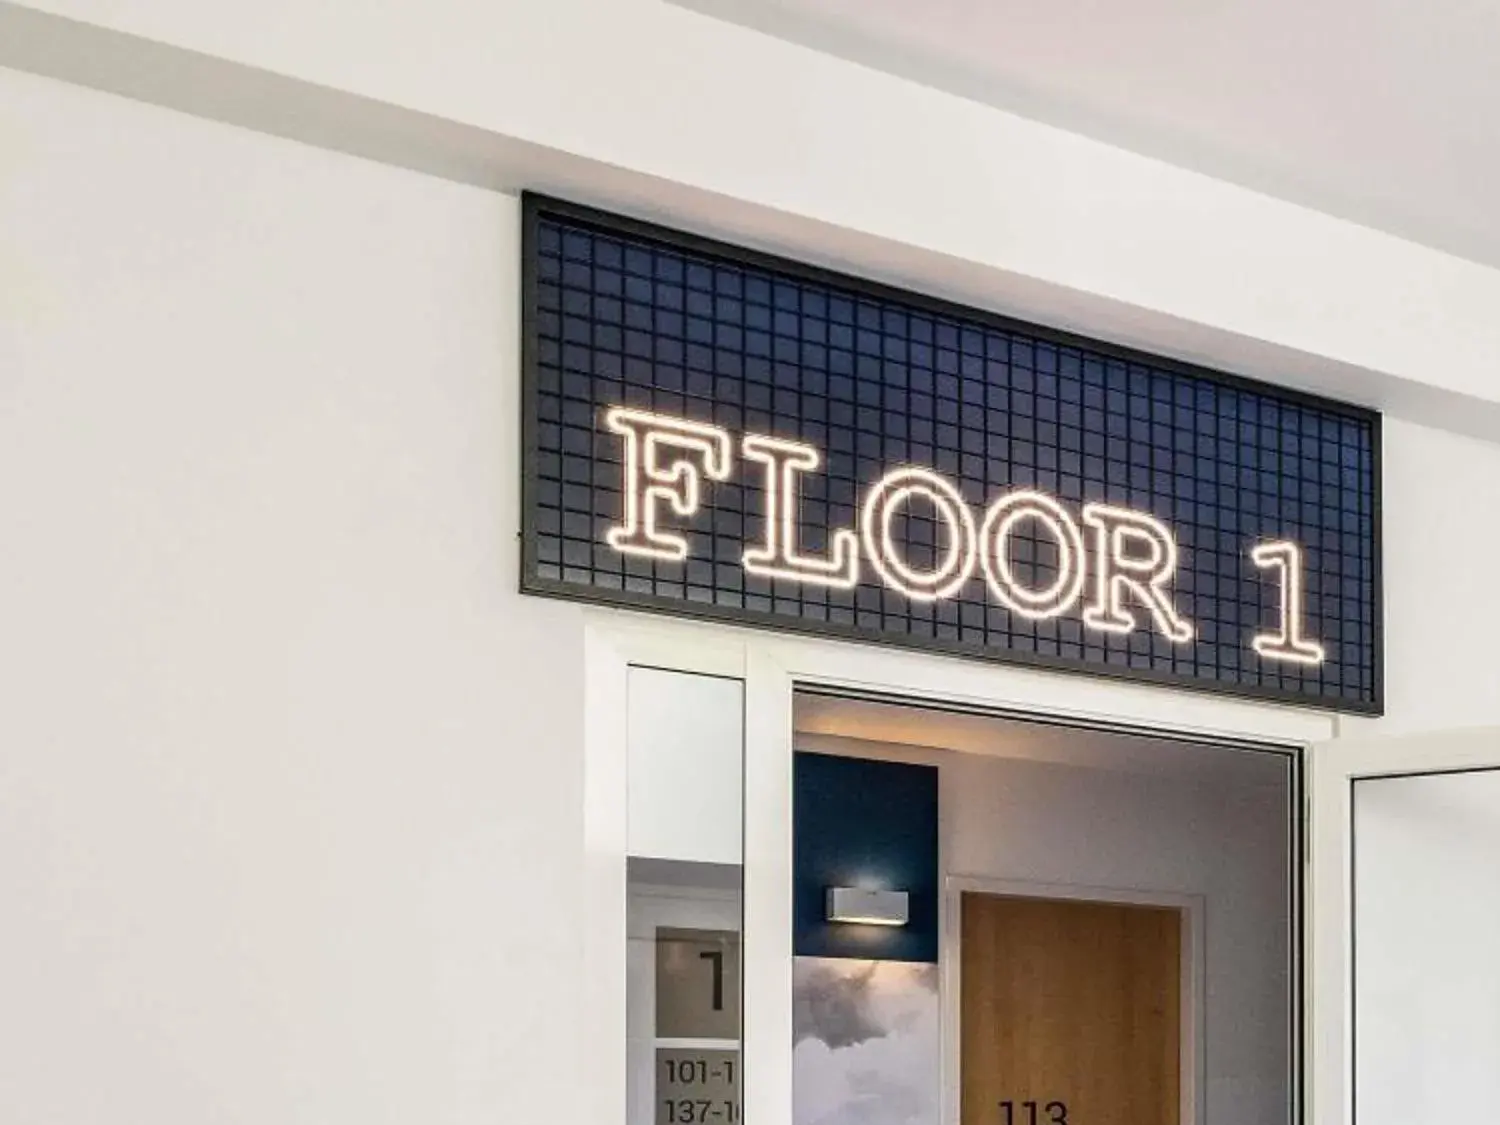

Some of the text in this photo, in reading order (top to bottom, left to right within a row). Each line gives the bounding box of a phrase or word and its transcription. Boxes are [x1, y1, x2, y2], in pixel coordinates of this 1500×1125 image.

[607, 407, 1325, 664] FLOOR 1
[699, 951, 723, 1011] 1
[664, 1099, 739, 1123] 137-1
